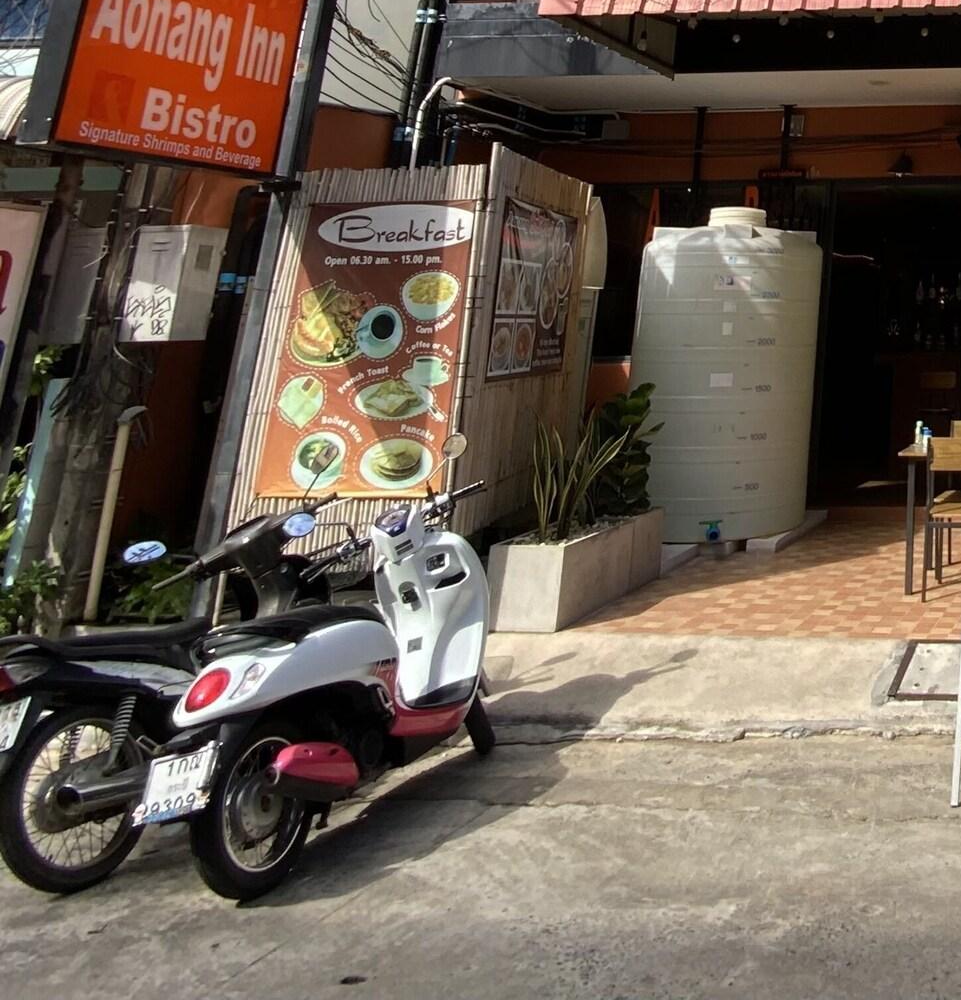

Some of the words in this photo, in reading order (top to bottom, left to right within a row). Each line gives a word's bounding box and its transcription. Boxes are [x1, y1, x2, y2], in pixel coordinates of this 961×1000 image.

[235, 2, 286, 86] Inn
[140, 87, 257, 149] Bistro
[79, 120, 140, 147] Signature
[143, 133, 191, 158] Shrimps
[192, 143, 213, 160] and
[214, 147, 262, 169] Beverage
[333, 214, 466, 244] Breakfast
[324, 256, 348, 268] Open
[350, 255, 373, 266] 06.30
[374, 257, 391, 266] am.
[401, 254, 424, 265] 15.00
[425, 255, 443, 267] pm.
[415, 325, 433, 334] Corn
[405, 340, 431, 354] Coffee
[442, 344, 454, 357] Tea
[337, 372, 365, 395] French
[366, 365, 389, 377] Toast
[321, 415, 351, 429] Boiled
[348, 424, 363, 443] Rice
[400, 423, 436, 442] Pancake
